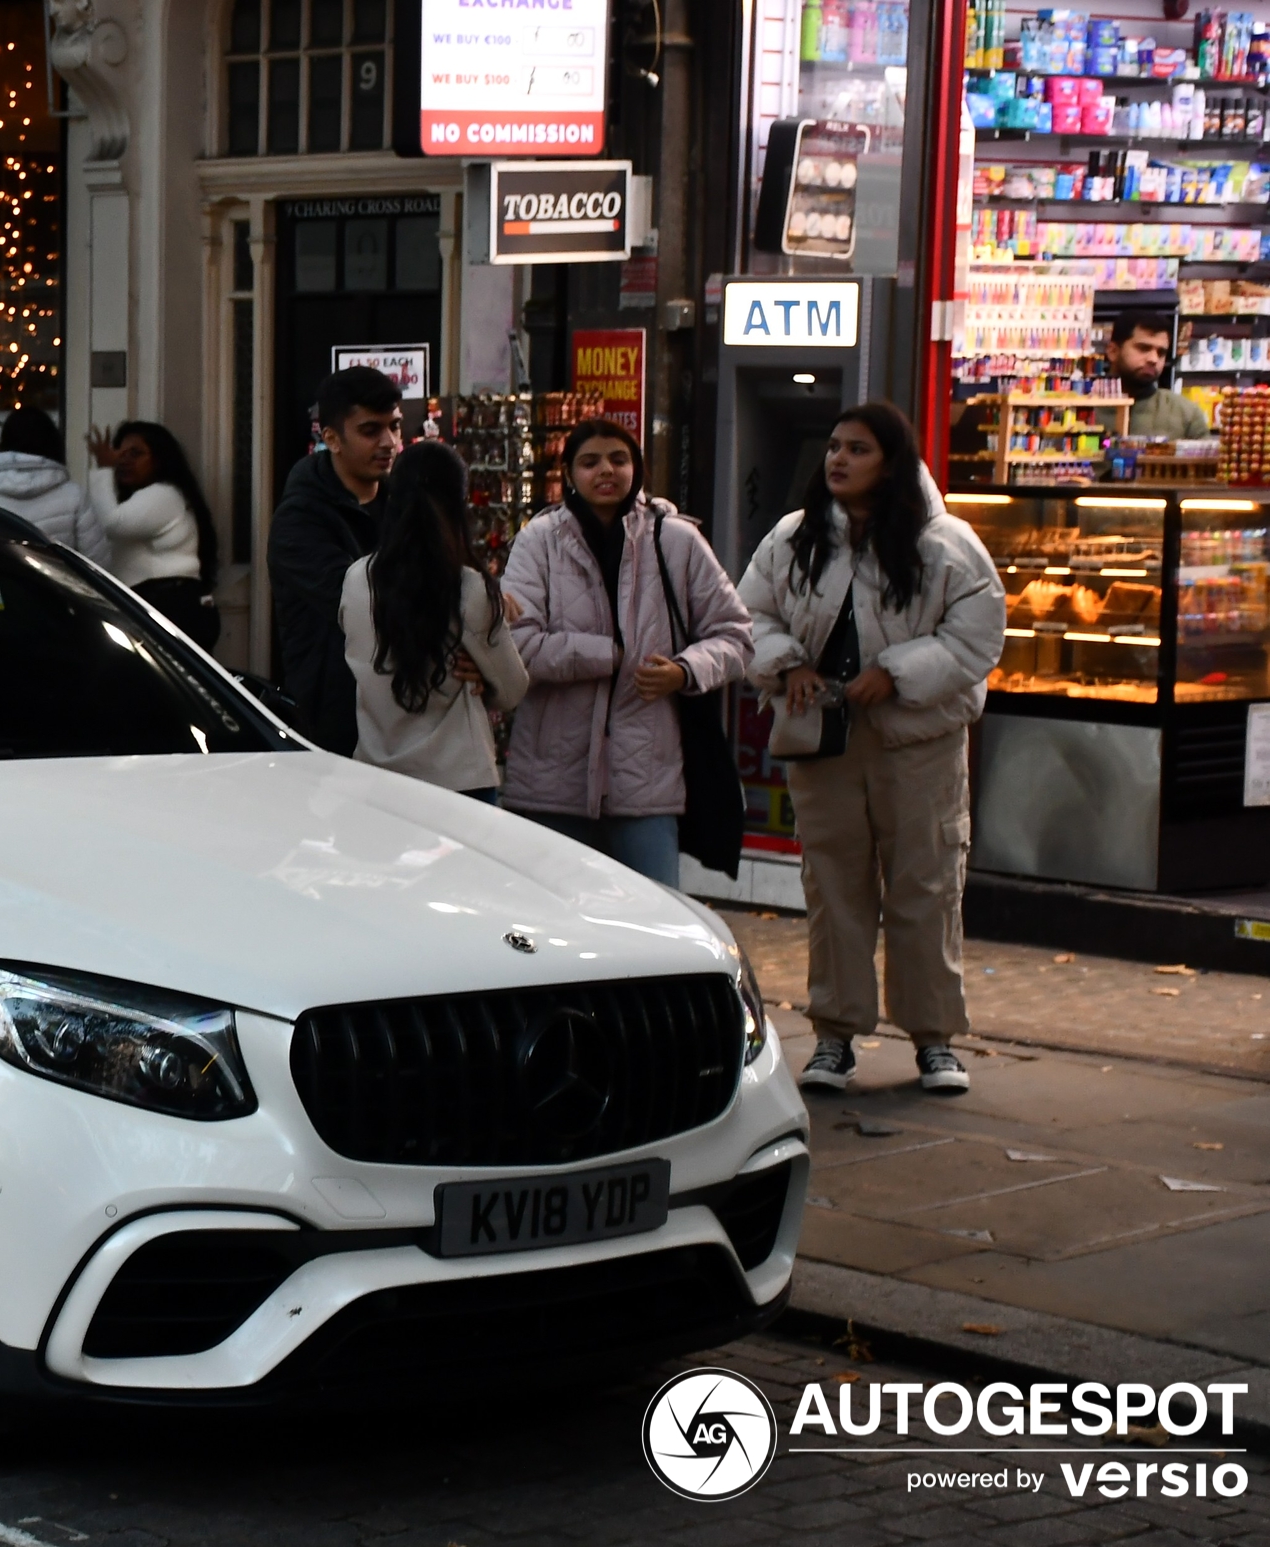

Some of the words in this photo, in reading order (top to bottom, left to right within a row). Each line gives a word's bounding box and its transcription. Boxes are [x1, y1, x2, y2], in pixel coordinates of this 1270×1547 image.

[433, 34, 451, 44] WE
[457, 34, 480, 44] BUY
[359, 60, 377, 91] 9
[432, 73, 451, 84] WE
[456, 74, 479, 85] BUY
[485, 74, 510, 85] $100
[431, 123, 460, 142] NO
[467, 123, 594, 143] COMMISSION
[294, 200, 356, 218] CHARING
[358, 197, 401, 214] CROSS
[504, 192, 621, 221] TOBACCO
[743, 300, 841, 336] ATM
[383, 357, 413, 368] EACH
[577, 346, 639, 376] MONEY
[470, 1186, 568, 1245] KV18
[582, 1172, 651, 1231] YDP
